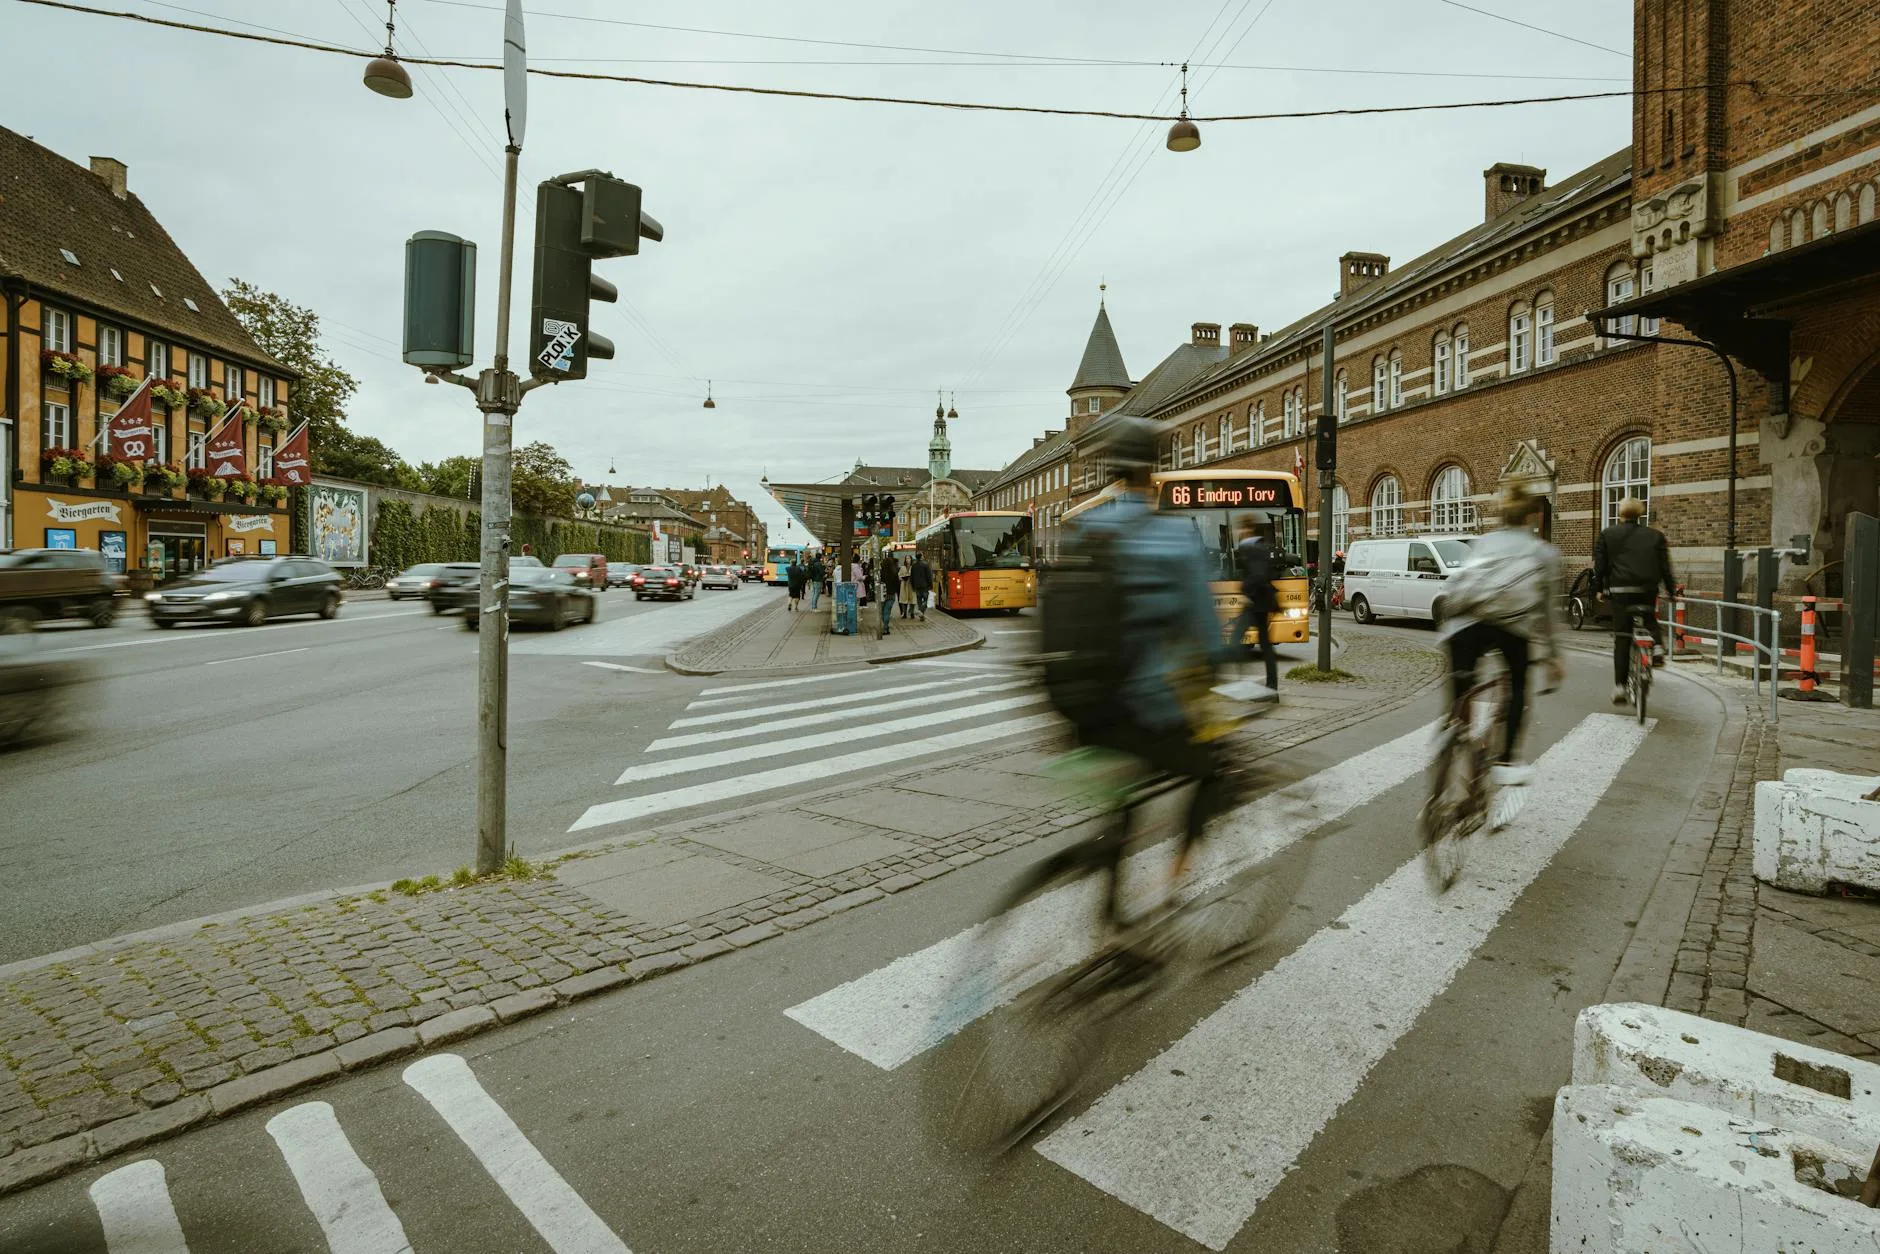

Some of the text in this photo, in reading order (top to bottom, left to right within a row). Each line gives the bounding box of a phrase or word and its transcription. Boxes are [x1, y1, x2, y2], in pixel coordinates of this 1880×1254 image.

[1172, 486, 1276, 505] 66 Emdrup Torv
[60, 505, 111, 518] Biergarten
